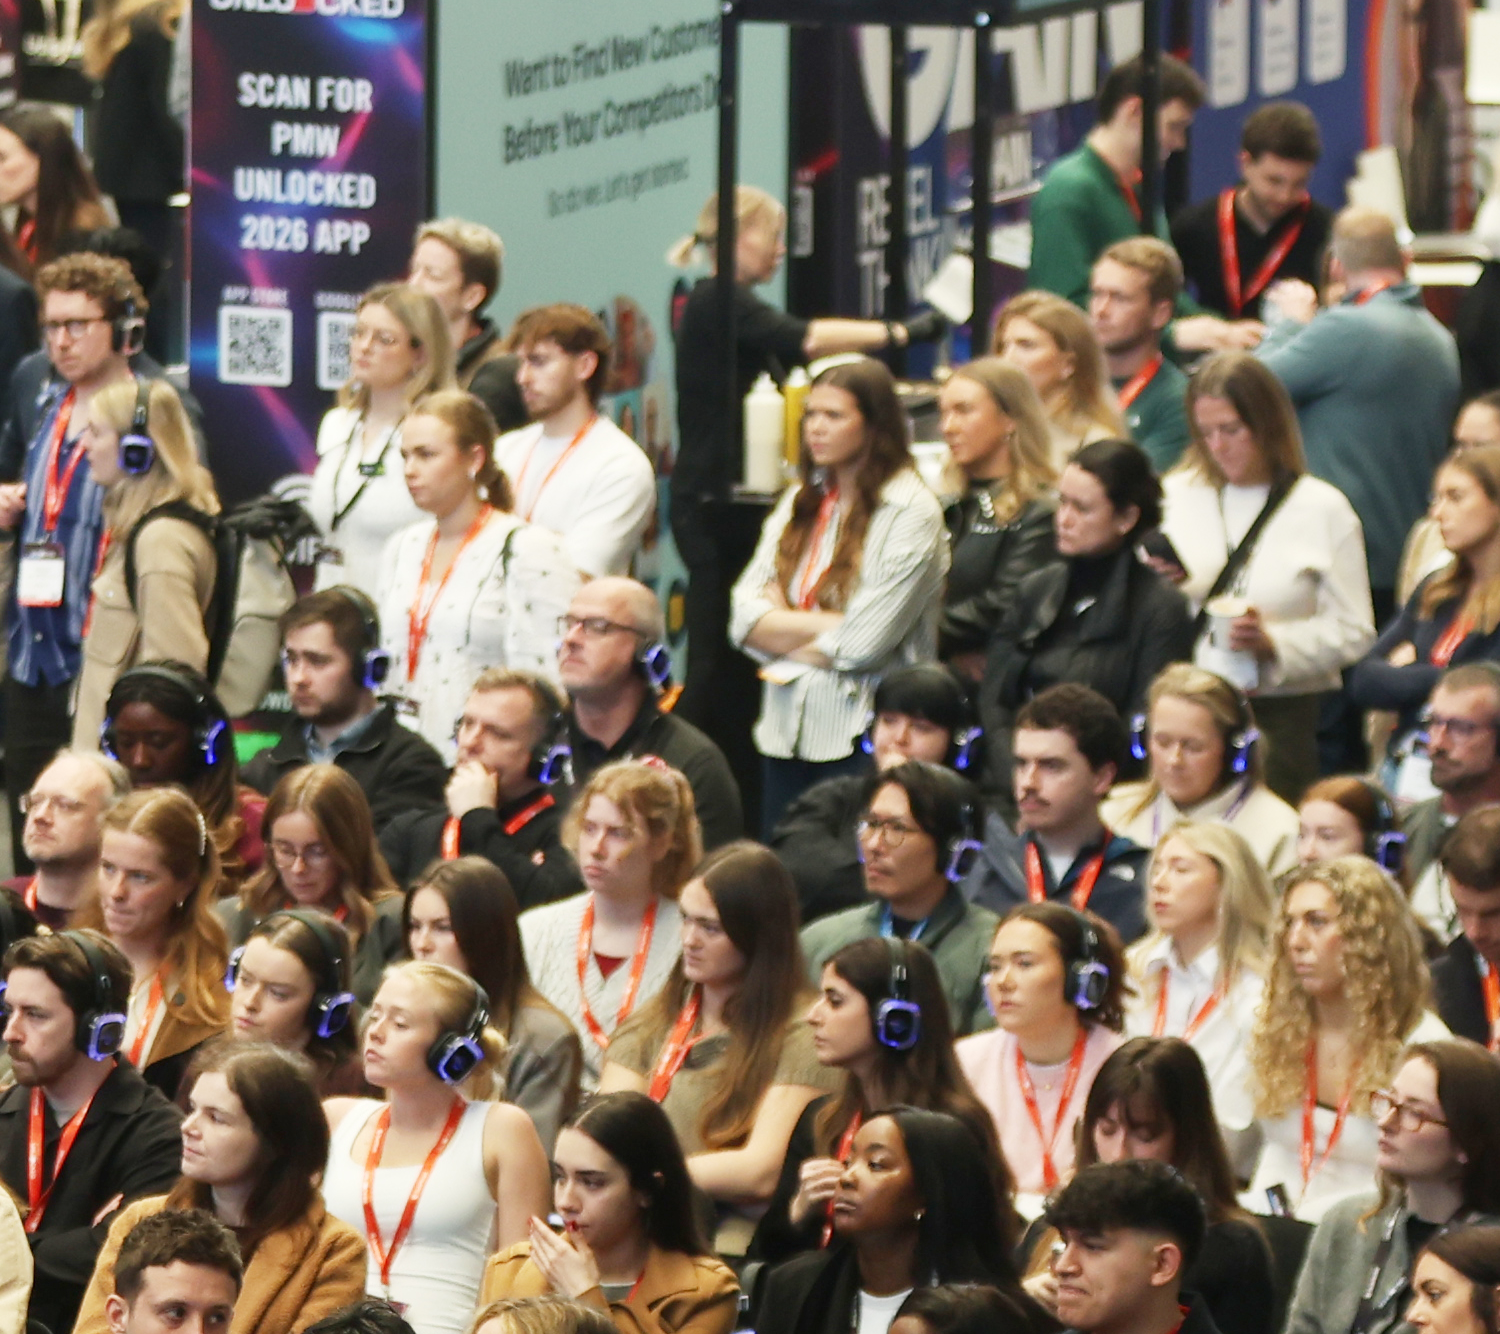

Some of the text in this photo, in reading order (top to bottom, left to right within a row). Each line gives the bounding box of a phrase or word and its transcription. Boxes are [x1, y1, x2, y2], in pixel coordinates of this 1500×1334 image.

[503, 17, 721, 99] Want to Find New Custome
[235, 71, 374, 114] SCAN FOR
[270, 120, 342, 158] PMW
[502, 81, 702, 166] Before Your Competitors
[233, 165, 378, 209] UNLOCKED
[239, 214, 372, 257] 2026 APP
